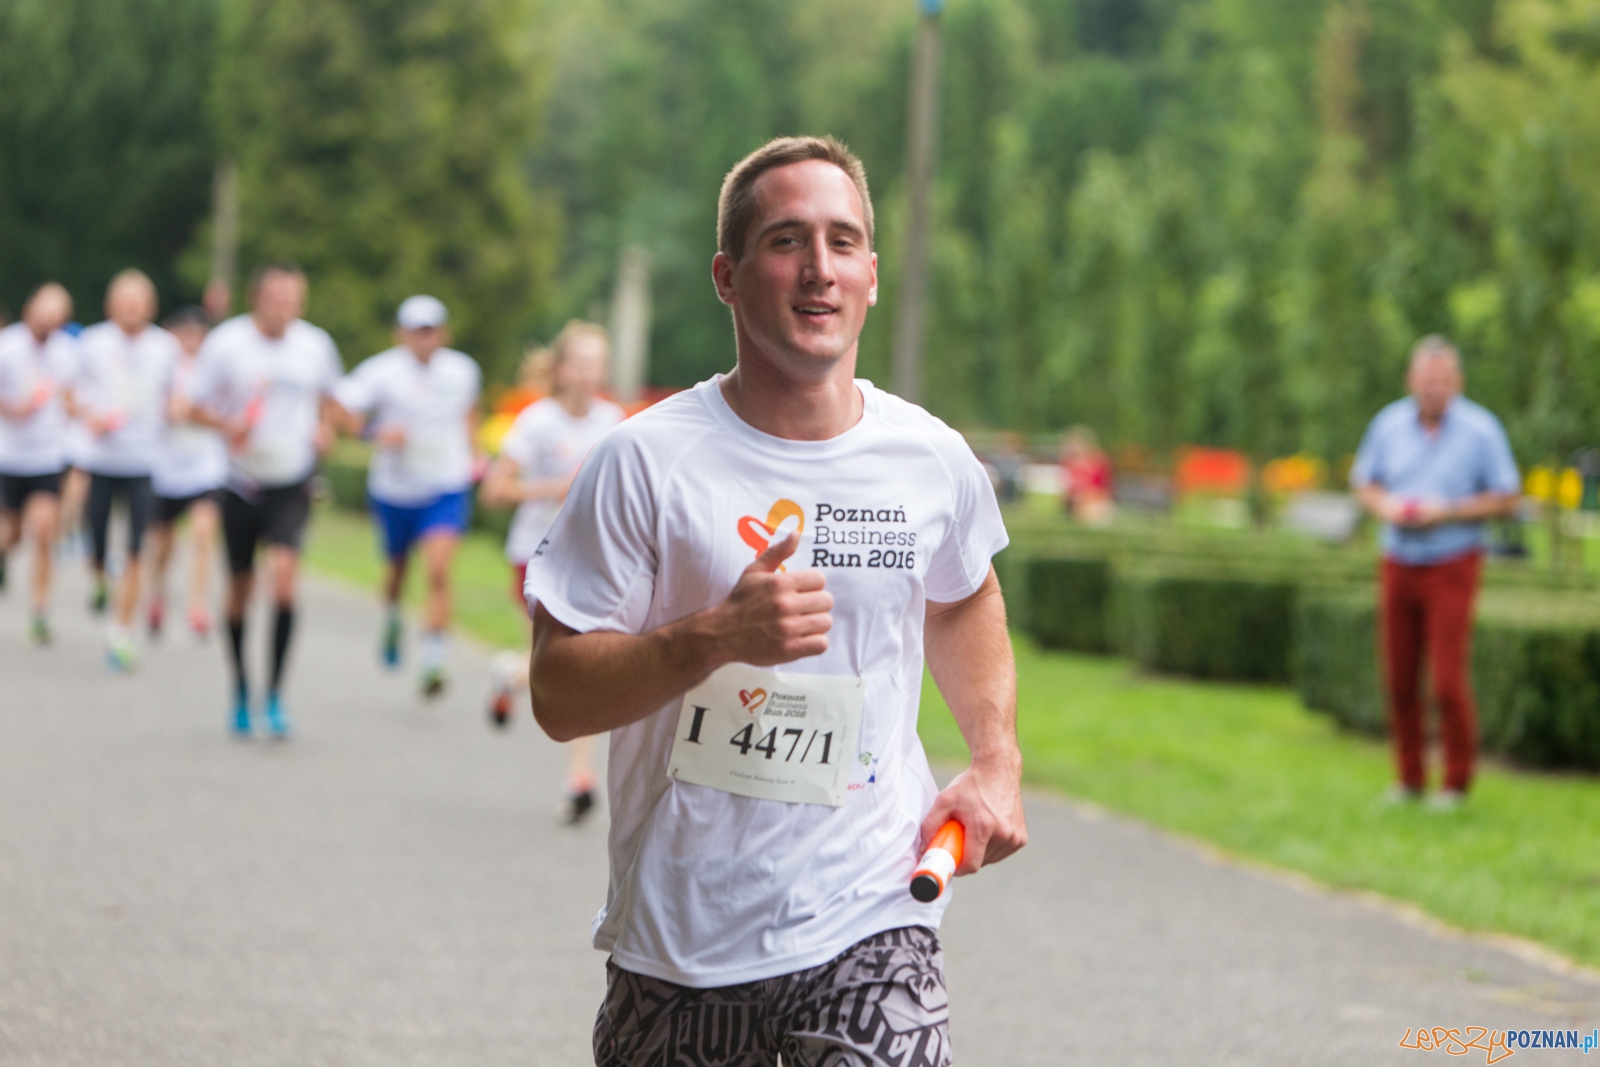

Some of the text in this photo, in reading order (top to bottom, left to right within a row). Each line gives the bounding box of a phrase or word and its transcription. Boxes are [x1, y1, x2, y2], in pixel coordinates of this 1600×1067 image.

[815, 504, 907, 523] Poznań
[813, 526, 917, 547] Business
[811, 549, 915, 570] Run 2016
[763, 708, 806, 718] Run 2016
[730, 723, 833, 765] 447/1
